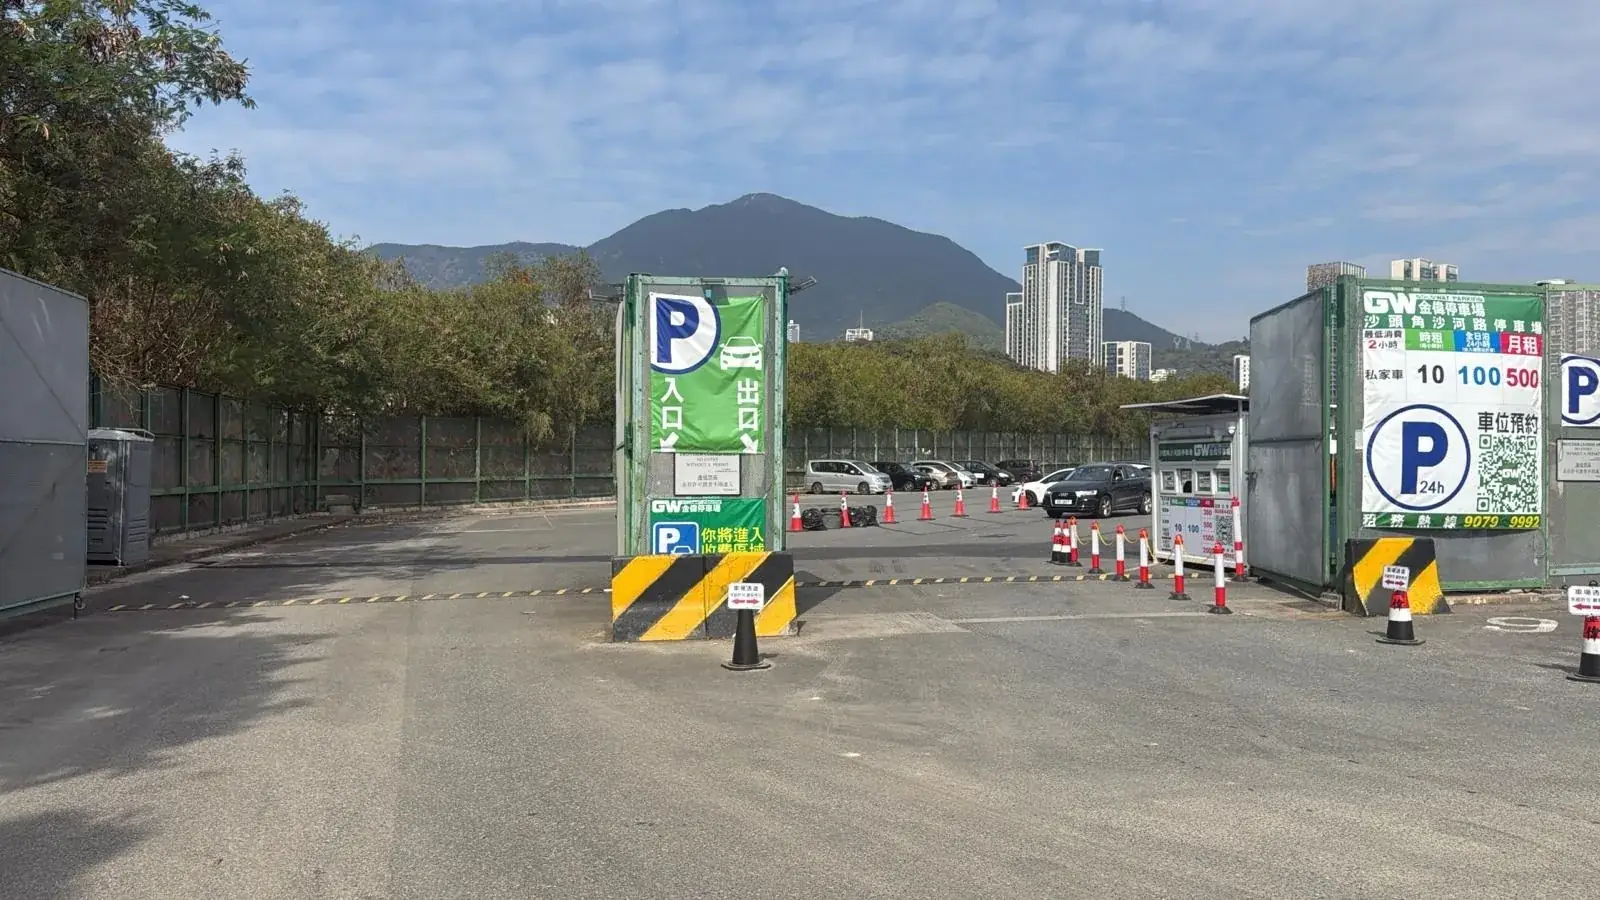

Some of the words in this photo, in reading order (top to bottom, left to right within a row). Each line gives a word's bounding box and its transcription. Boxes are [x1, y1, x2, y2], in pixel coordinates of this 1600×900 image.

[1363, 291, 1417, 314] GW
[656, 297, 700, 363] P
[1363, 314, 1542, 334] 沙頭角沙河路停車場
[1419, 332, 1443, 344] 時租
[1507, 335, 1538, 355] 月租
[1364, 369, 1404, 380] 私家車
[1418, 364, 1445, 384] 10
[1458, 365, 1501, 386] 100
[1506, 367, 1539, 389] 500
[1568, 366, 1599, 414] P
[660, 377, 684, 430] 入口
[737, 377, 759, 431] 出口
[1478, 411, 1538, 434] 車位預約
[1401, 421, 1449, 494] P
[1420, 481, 1445, 494] 24h
[652, 500, 681, 513] GW
[1187, 524, 1200, 533] 100
[1463, 515, 1499, 528] 9079
[1509, 516, 1541, 528] 9992
[659, 527, 681, 553] P
[701, 526, 764, 543] 你將進入
